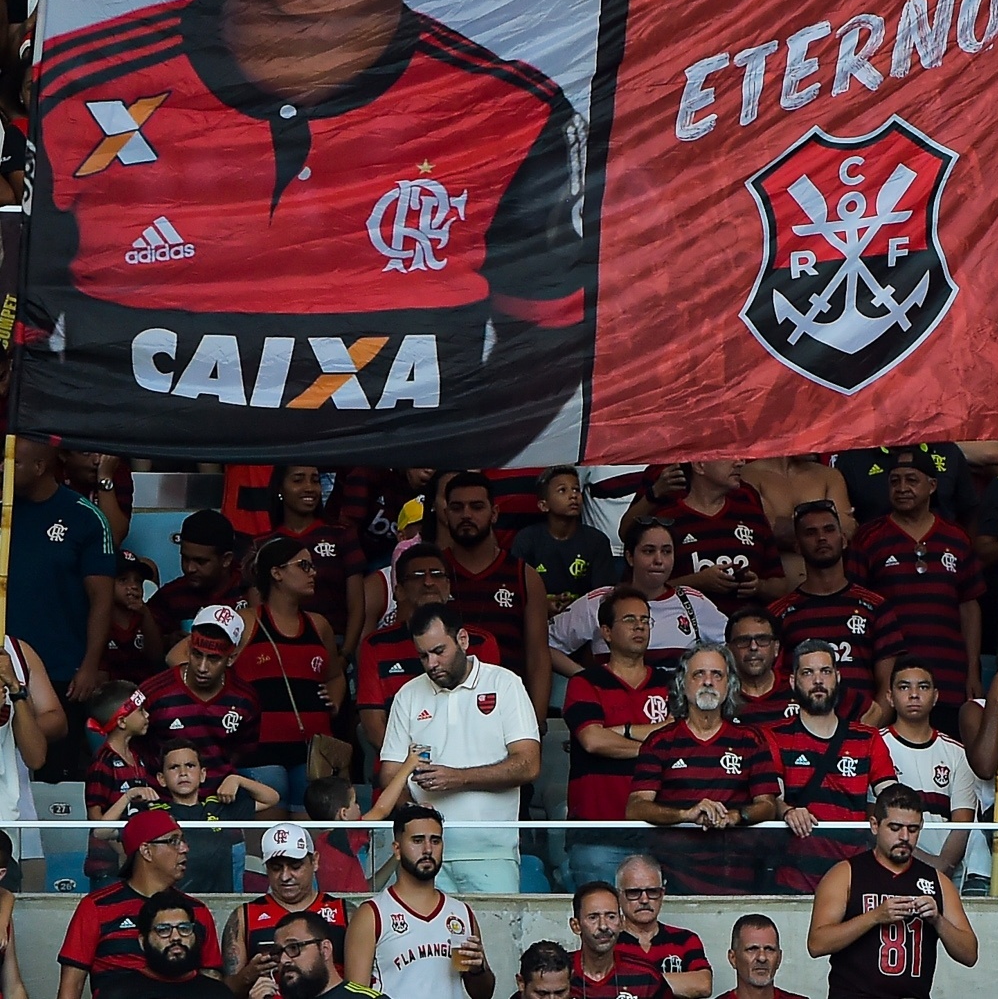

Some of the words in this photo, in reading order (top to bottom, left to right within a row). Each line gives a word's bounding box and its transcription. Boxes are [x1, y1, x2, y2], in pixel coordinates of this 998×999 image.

[125, 243, 195, 265] adidas
[130, 327, 442, 410] CAIXA
[393, 951, 417, 971] FLA
[879, 919, 926, 978] 81
